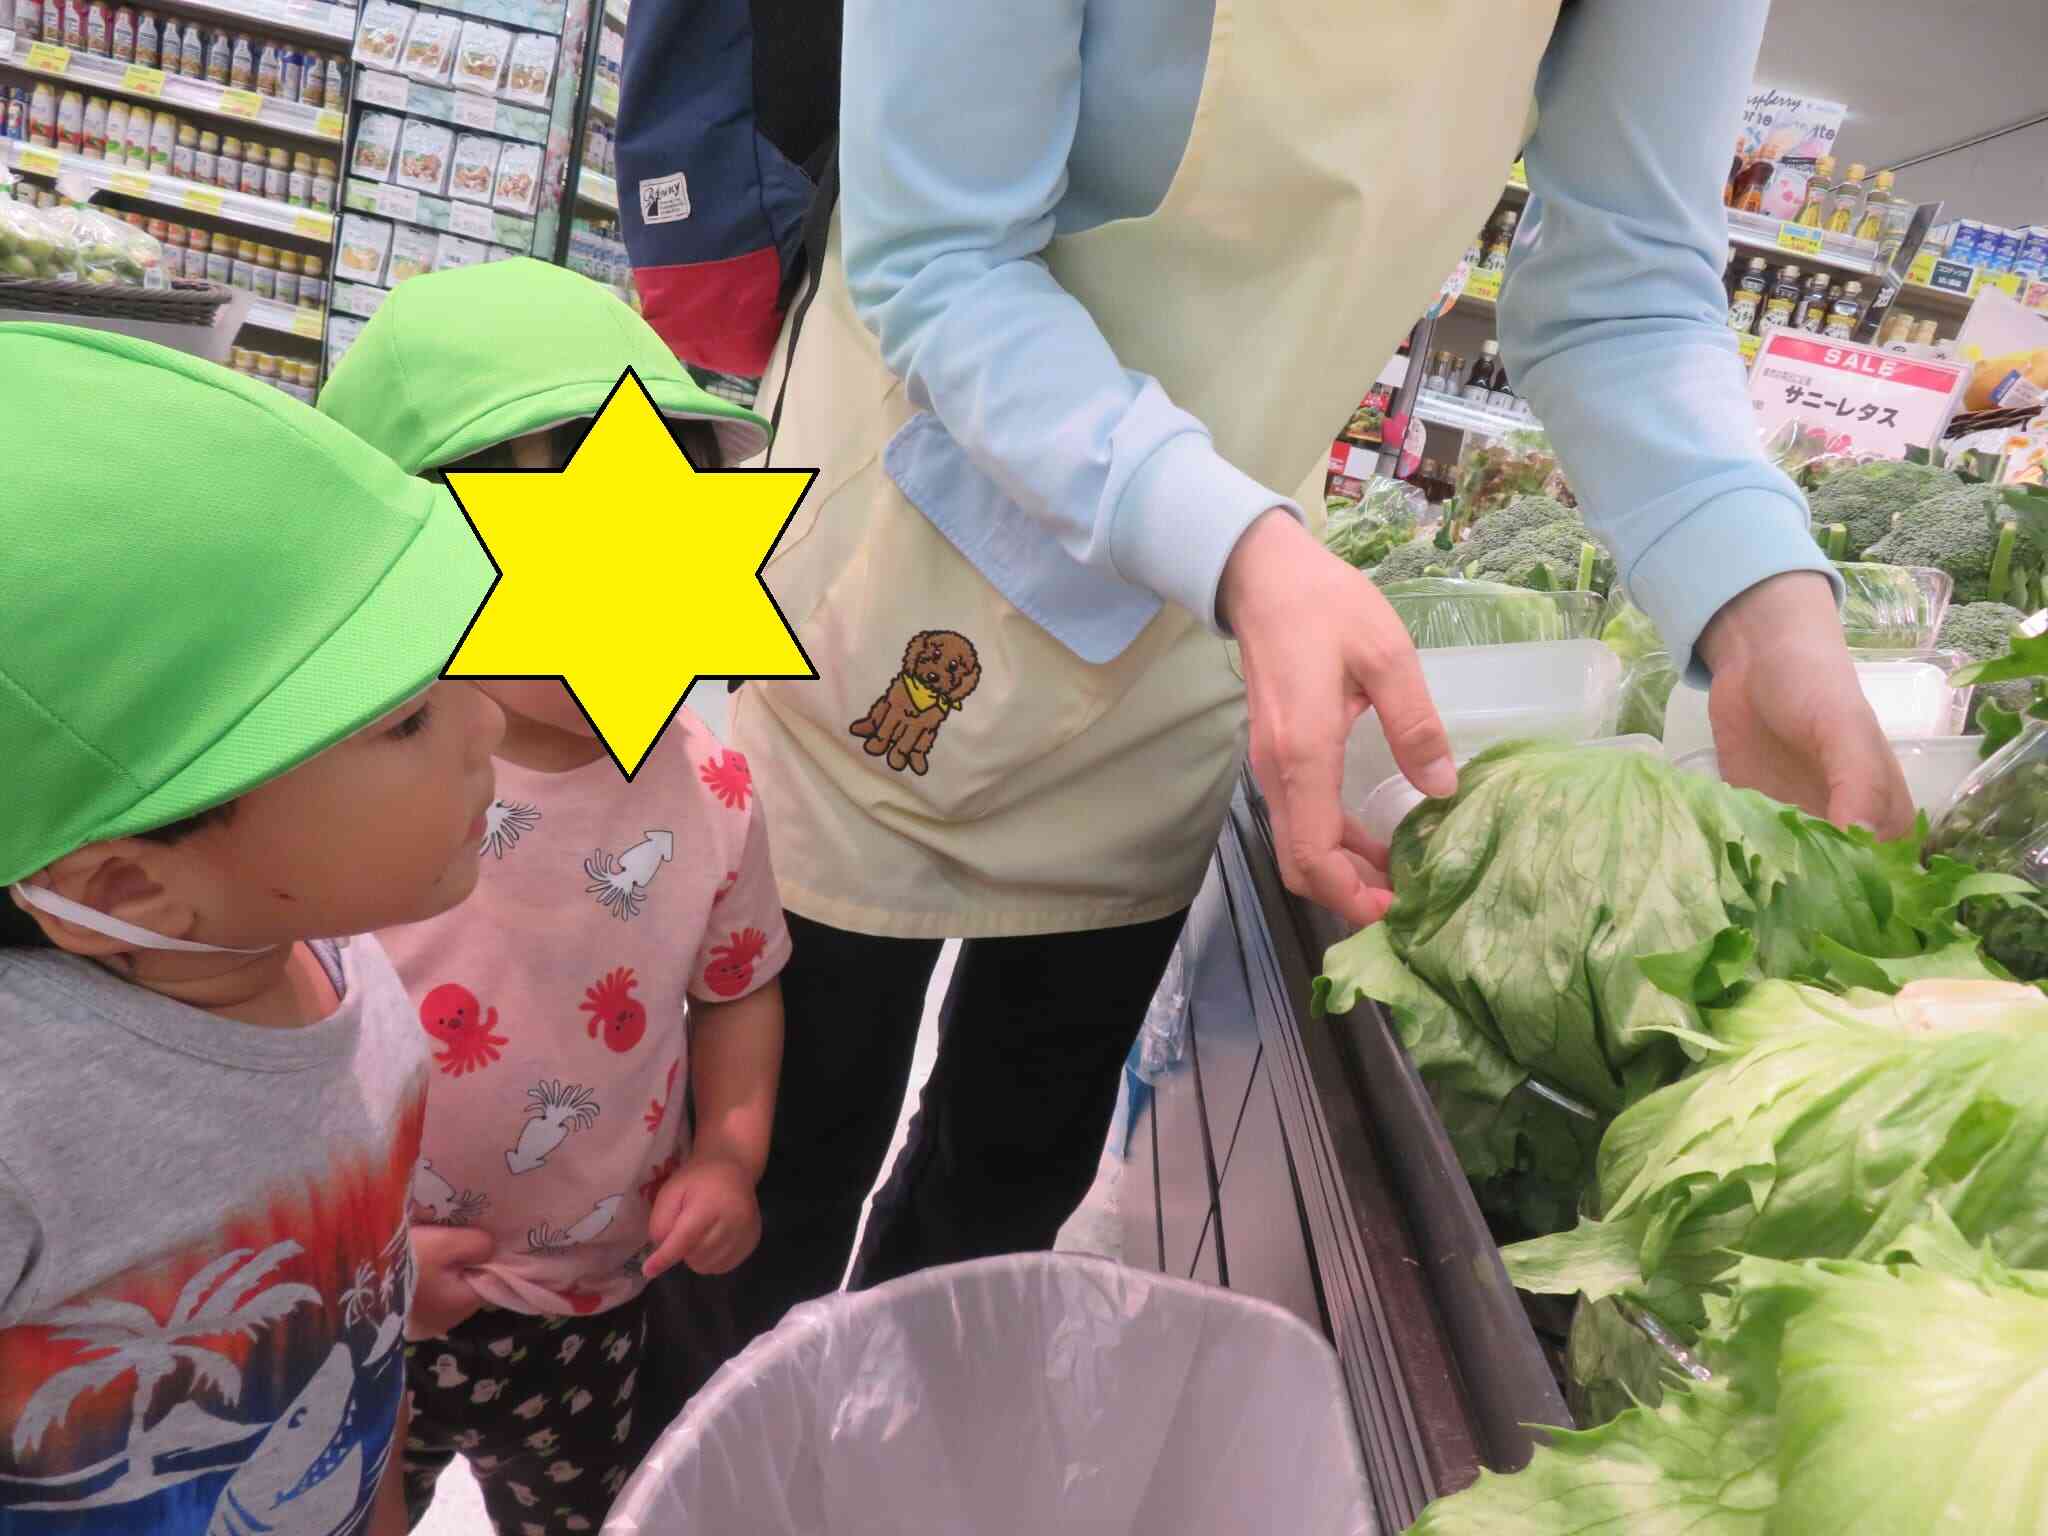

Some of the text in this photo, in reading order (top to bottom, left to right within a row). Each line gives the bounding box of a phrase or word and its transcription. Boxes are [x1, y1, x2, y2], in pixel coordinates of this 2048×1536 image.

[1823, 348, 1896, 377] SALE
[1785, 385, 1899, 428] サニーレタス
